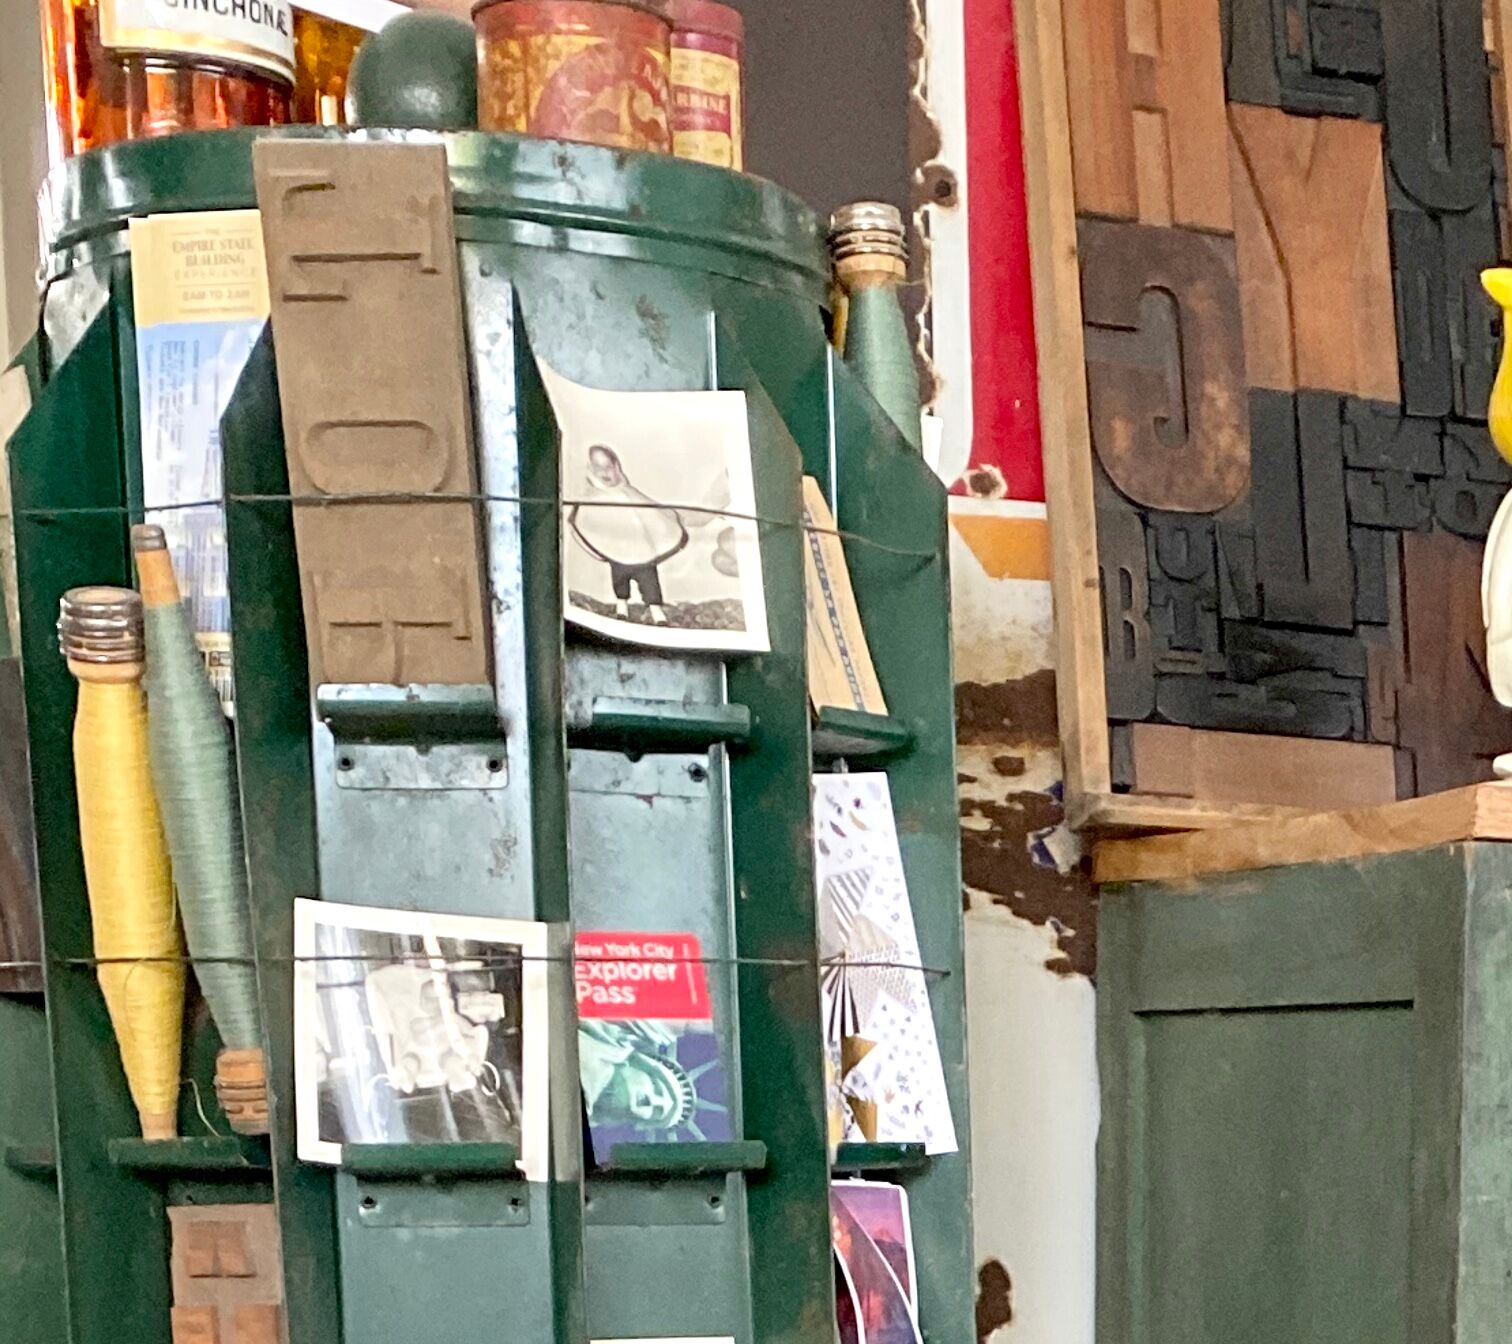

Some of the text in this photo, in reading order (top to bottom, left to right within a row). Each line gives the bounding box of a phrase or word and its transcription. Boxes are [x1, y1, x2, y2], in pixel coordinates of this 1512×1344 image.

[603, 942, 641, 957] York
[642, 942, 675, 959] City
[575, 960, 678, 984] Explorer
[575, 981, 637, 1005] Pass
